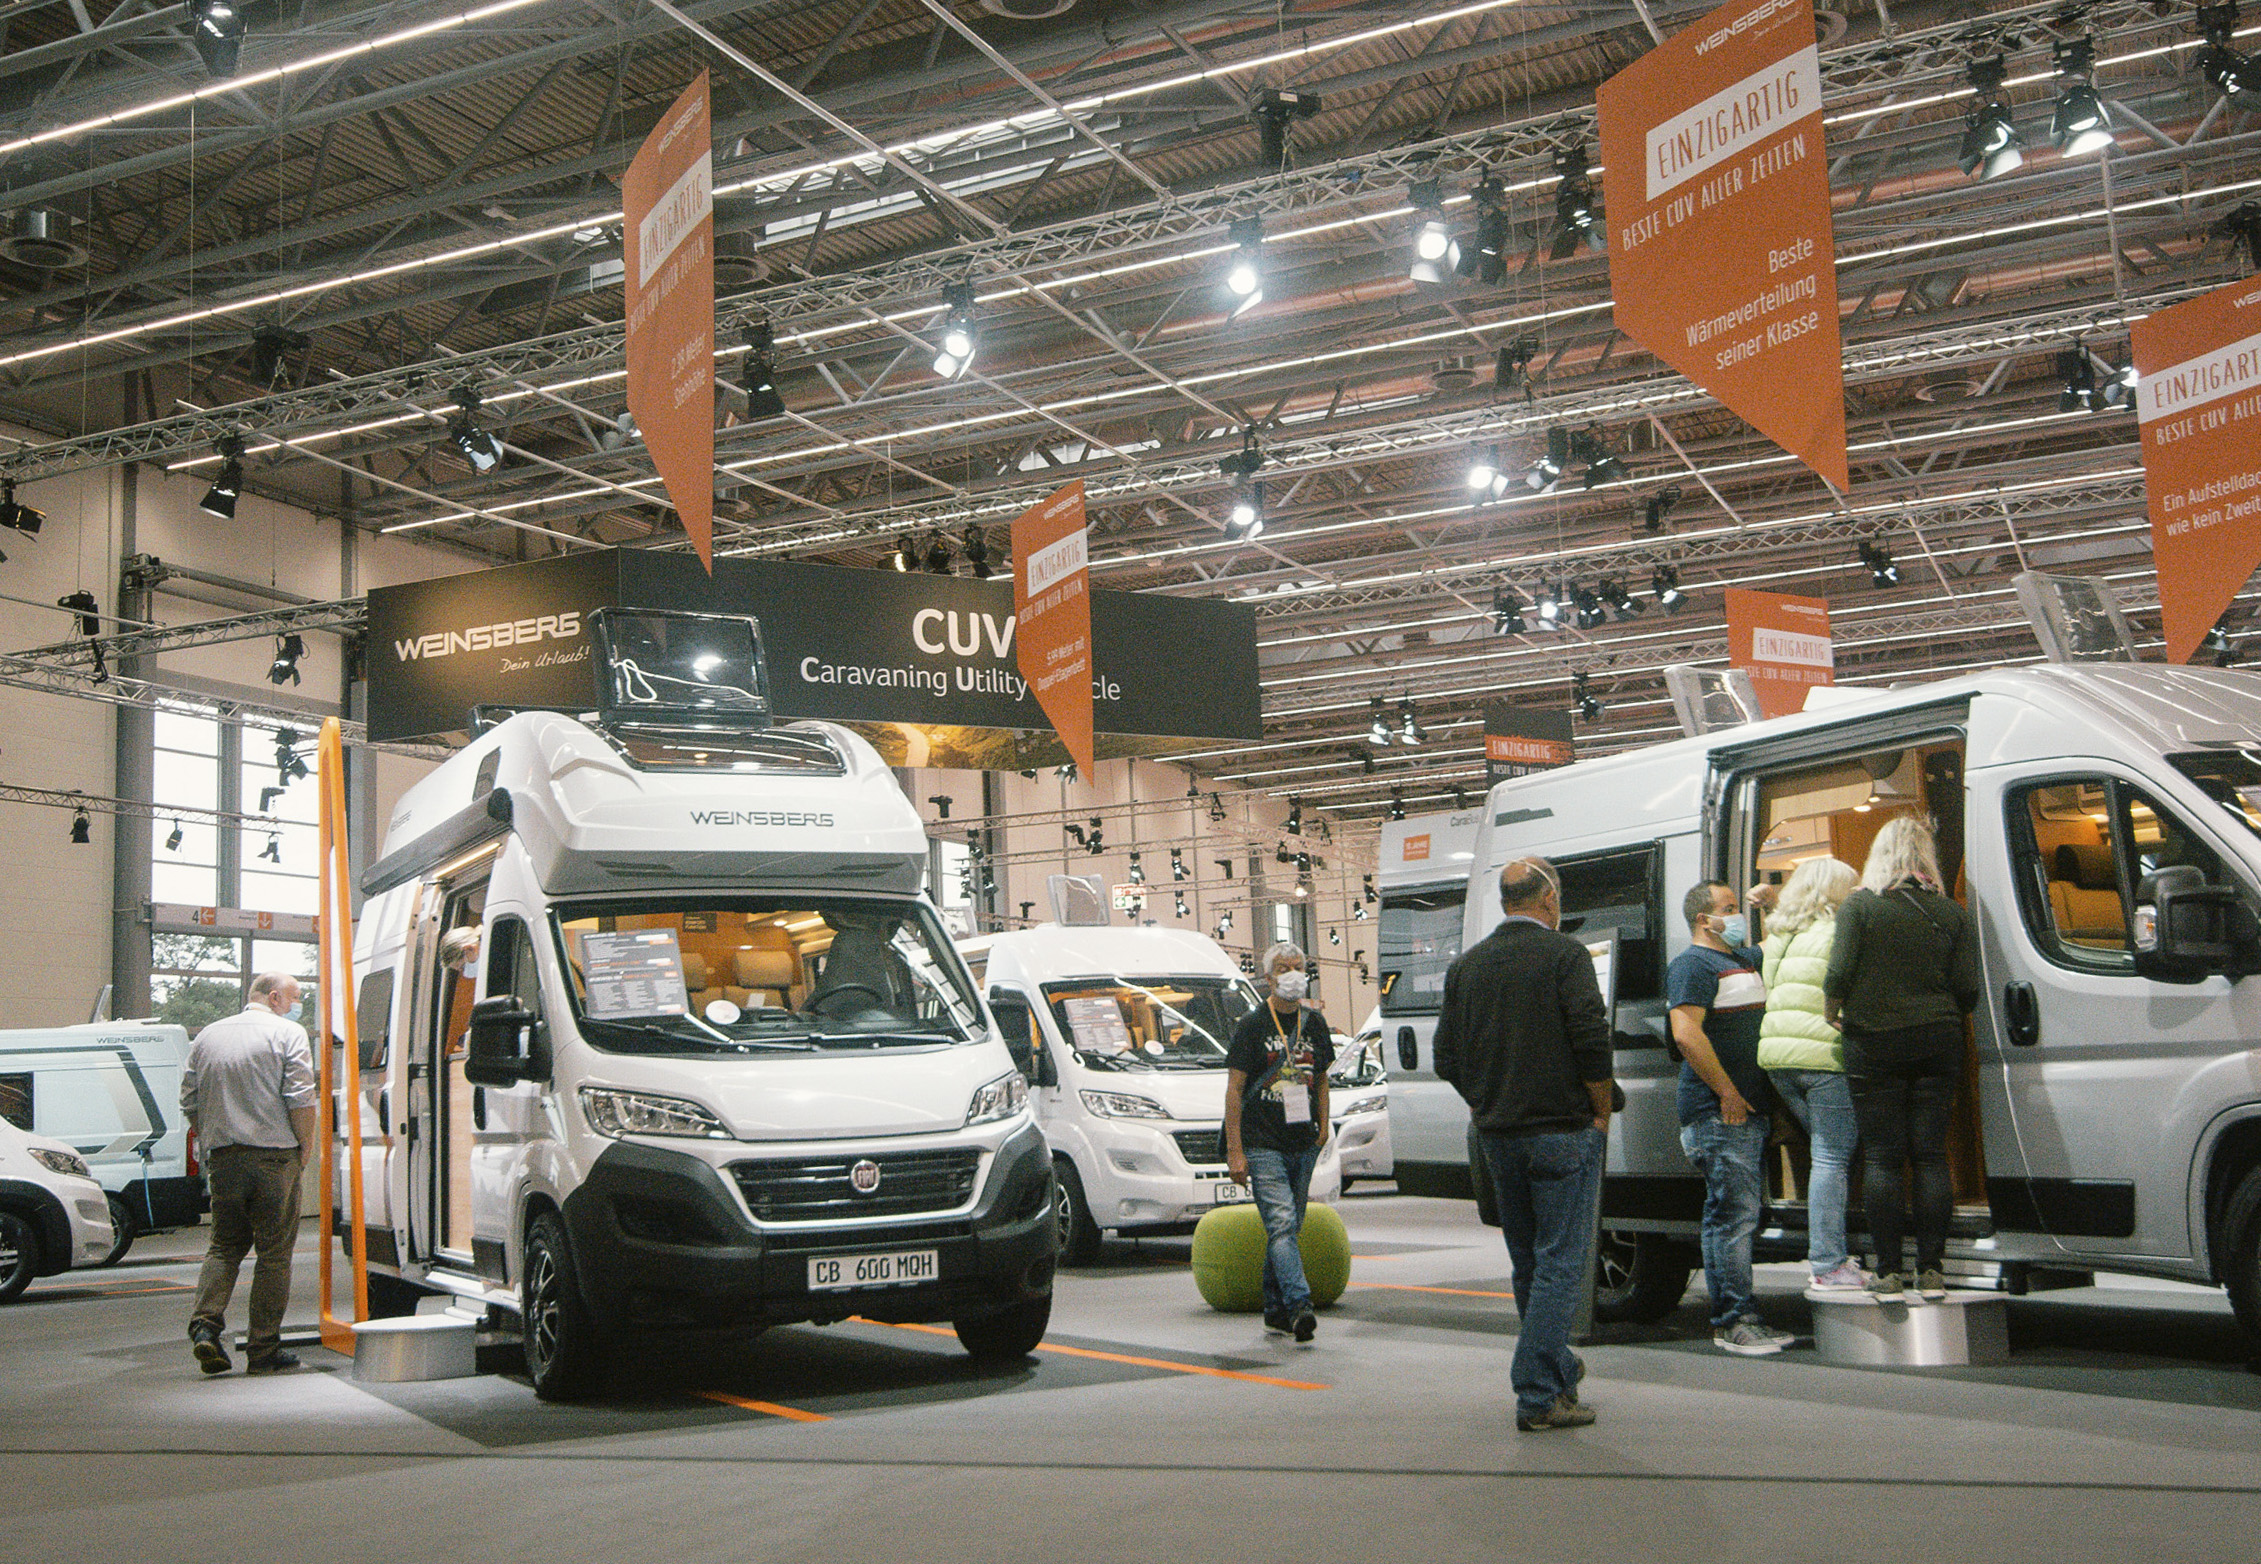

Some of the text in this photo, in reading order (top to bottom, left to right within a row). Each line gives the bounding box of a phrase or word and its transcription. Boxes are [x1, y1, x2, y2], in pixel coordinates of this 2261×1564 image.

[1658, 70, 1798, 179] EINZIGARTIG
[1622, 133, 1806, 251] BESTE CUV ALLER ZEITEN
[643, 173, 703, 270] EINZIGARTIG
[1768, 238, 1814, 274] Beste
[1685, 274, 1817, 348] Wärmeverteilung
[1716, 311, 1818, 370] seiner Klasse
[2156, 418, 2195, 445] BESTE
[2200, 406, 2227, 431] CUV
[2163, 494, 2185, 512] Ein
[2166, 517, 2190, 537] wie
[2192, 509, 2222, 530] kein
[395, 611, 581, 662] WEINSBERG
[912, 608, 1016, 659] CUV
[1759, 637, 1824, 660] EINZIGARTIG
[500, 646, 590, 673] Dein Urlaub!
[800, 657, 948, 697] Caravaning
[956, 666, 1028, 701] Utility
[1492, 740, 1551, 760] EINZIGARTIG
[690, 811, 834, 827] WEINSBERG
[192, 910, 199, 923] 4
[96, 1035, 165, 1045] WEINSBERG
[1222, 1186, 1237, 1198] CB
[816, 1254, 932, 1283] CB 600 MQH
